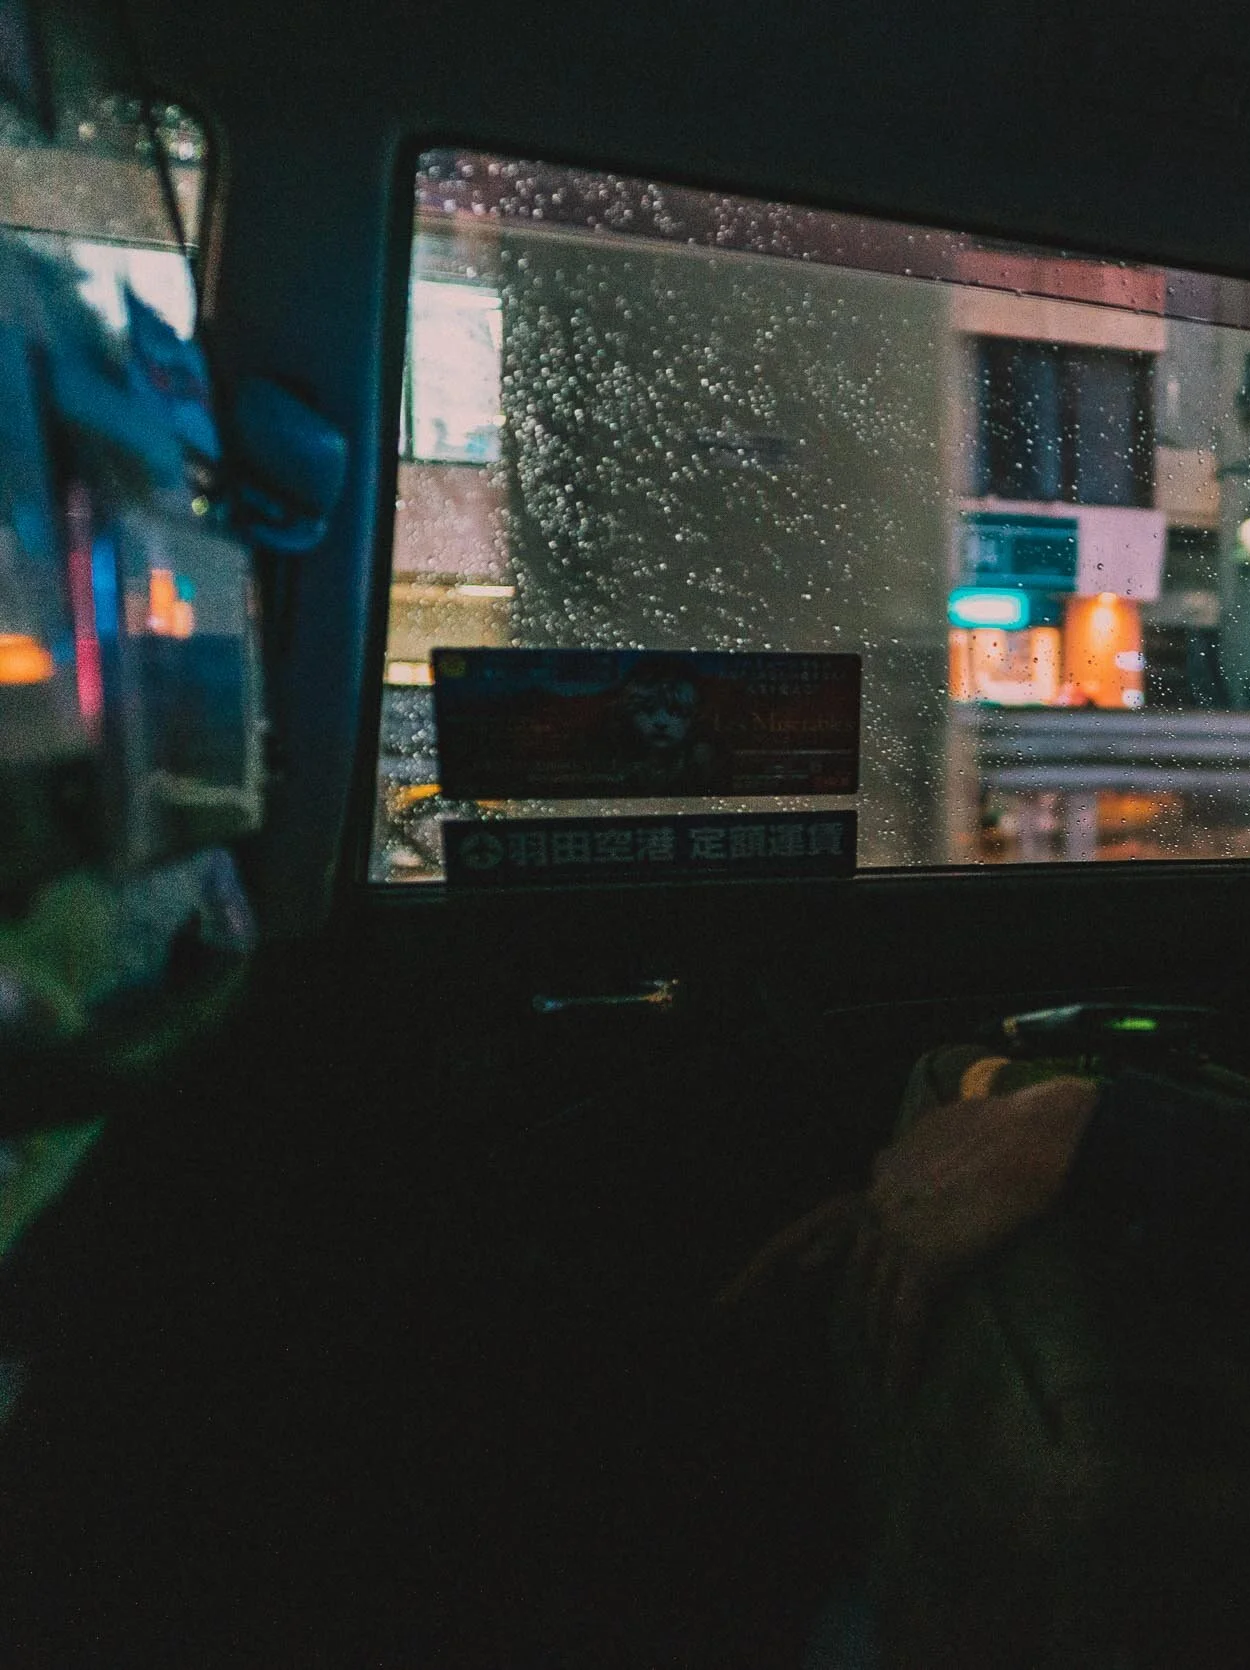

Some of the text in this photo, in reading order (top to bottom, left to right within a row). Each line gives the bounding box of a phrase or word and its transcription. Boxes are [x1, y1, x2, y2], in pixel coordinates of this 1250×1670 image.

[508, 822, 843, 867] 羽田空港 定額運賃
